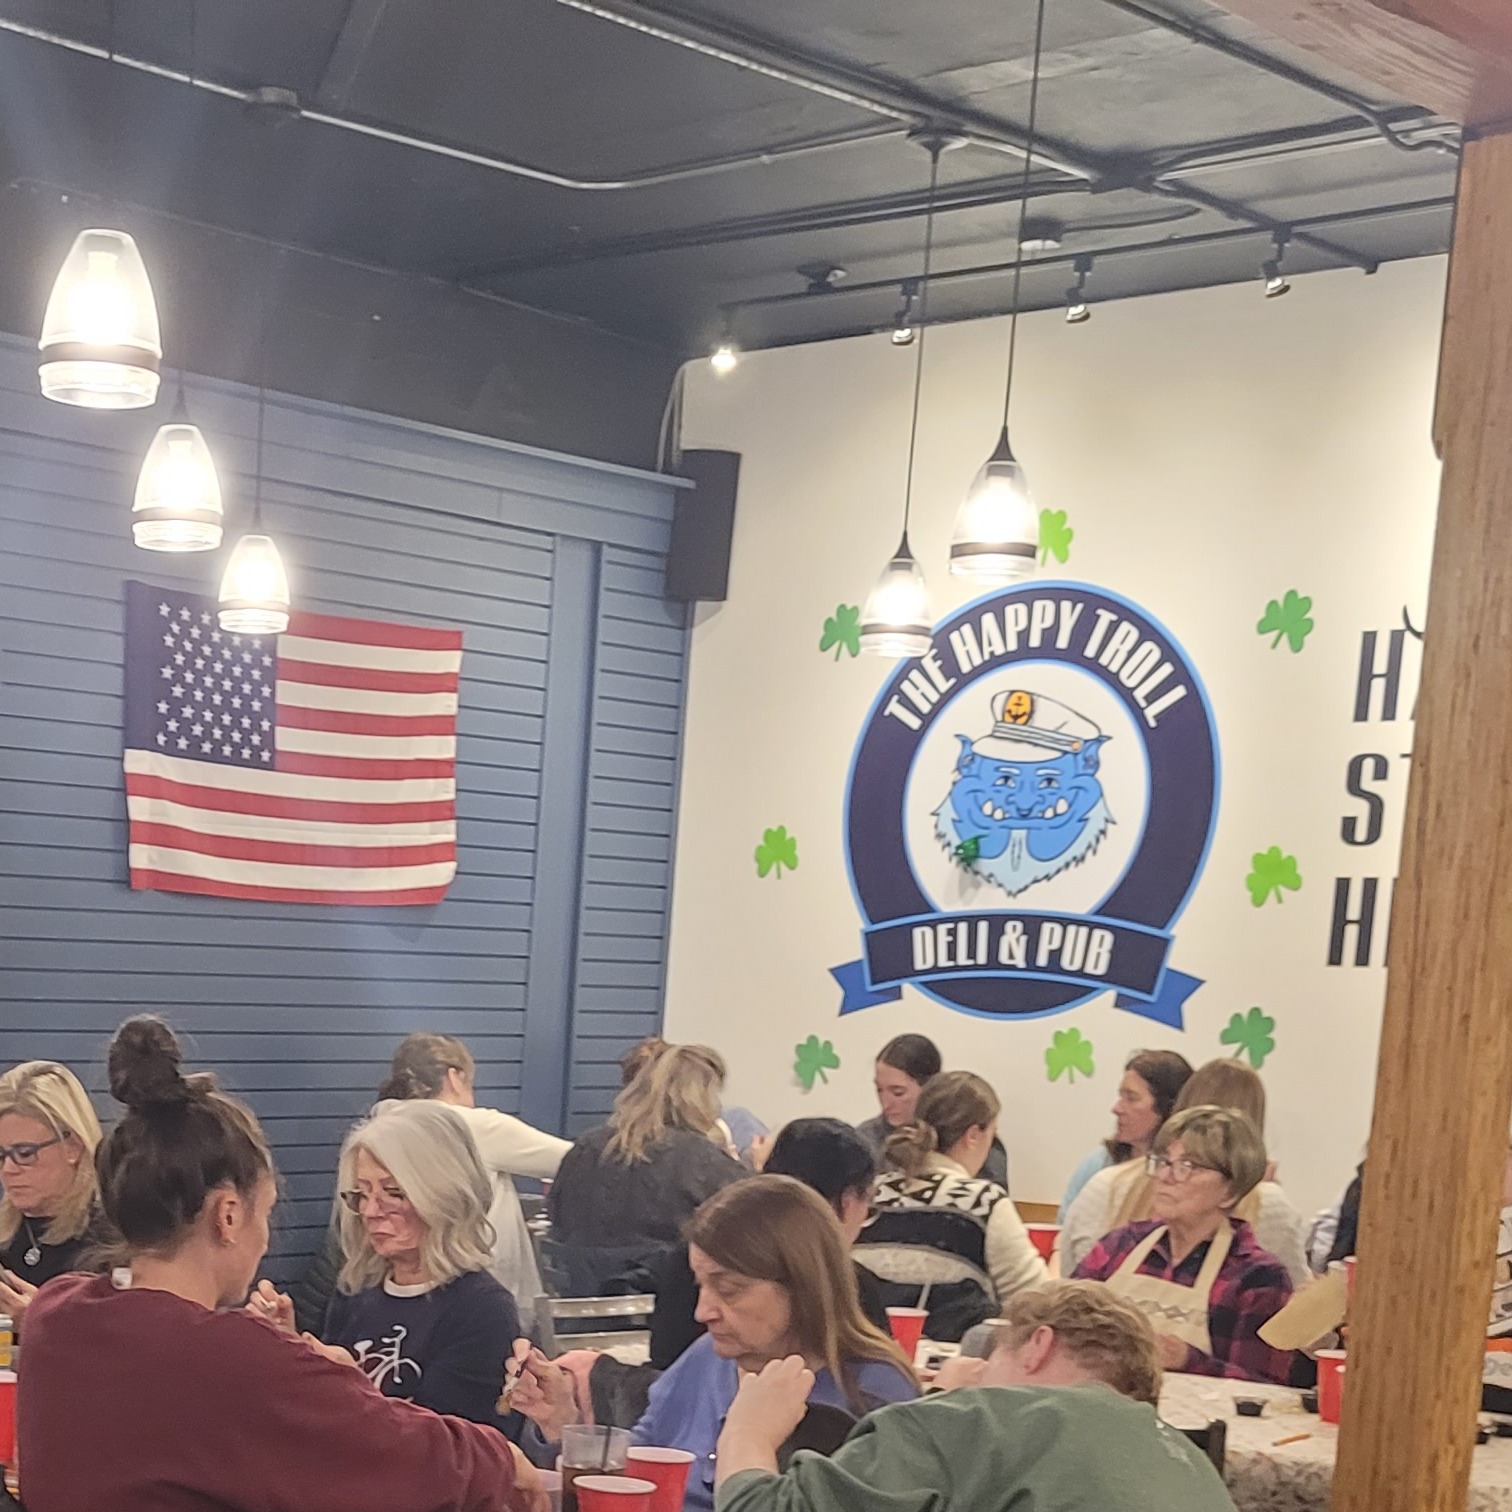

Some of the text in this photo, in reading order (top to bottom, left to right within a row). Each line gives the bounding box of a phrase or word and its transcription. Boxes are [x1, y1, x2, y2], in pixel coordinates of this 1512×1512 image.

[884, 599, 1188, 731] THE HAPPY TROLL
[1353, 629, 1416, 722] H
[1341, 753, 1412, 846] S
[911, 920, 1115, 976] DELI & PUB
[1326, 877, 1395, 968] H
